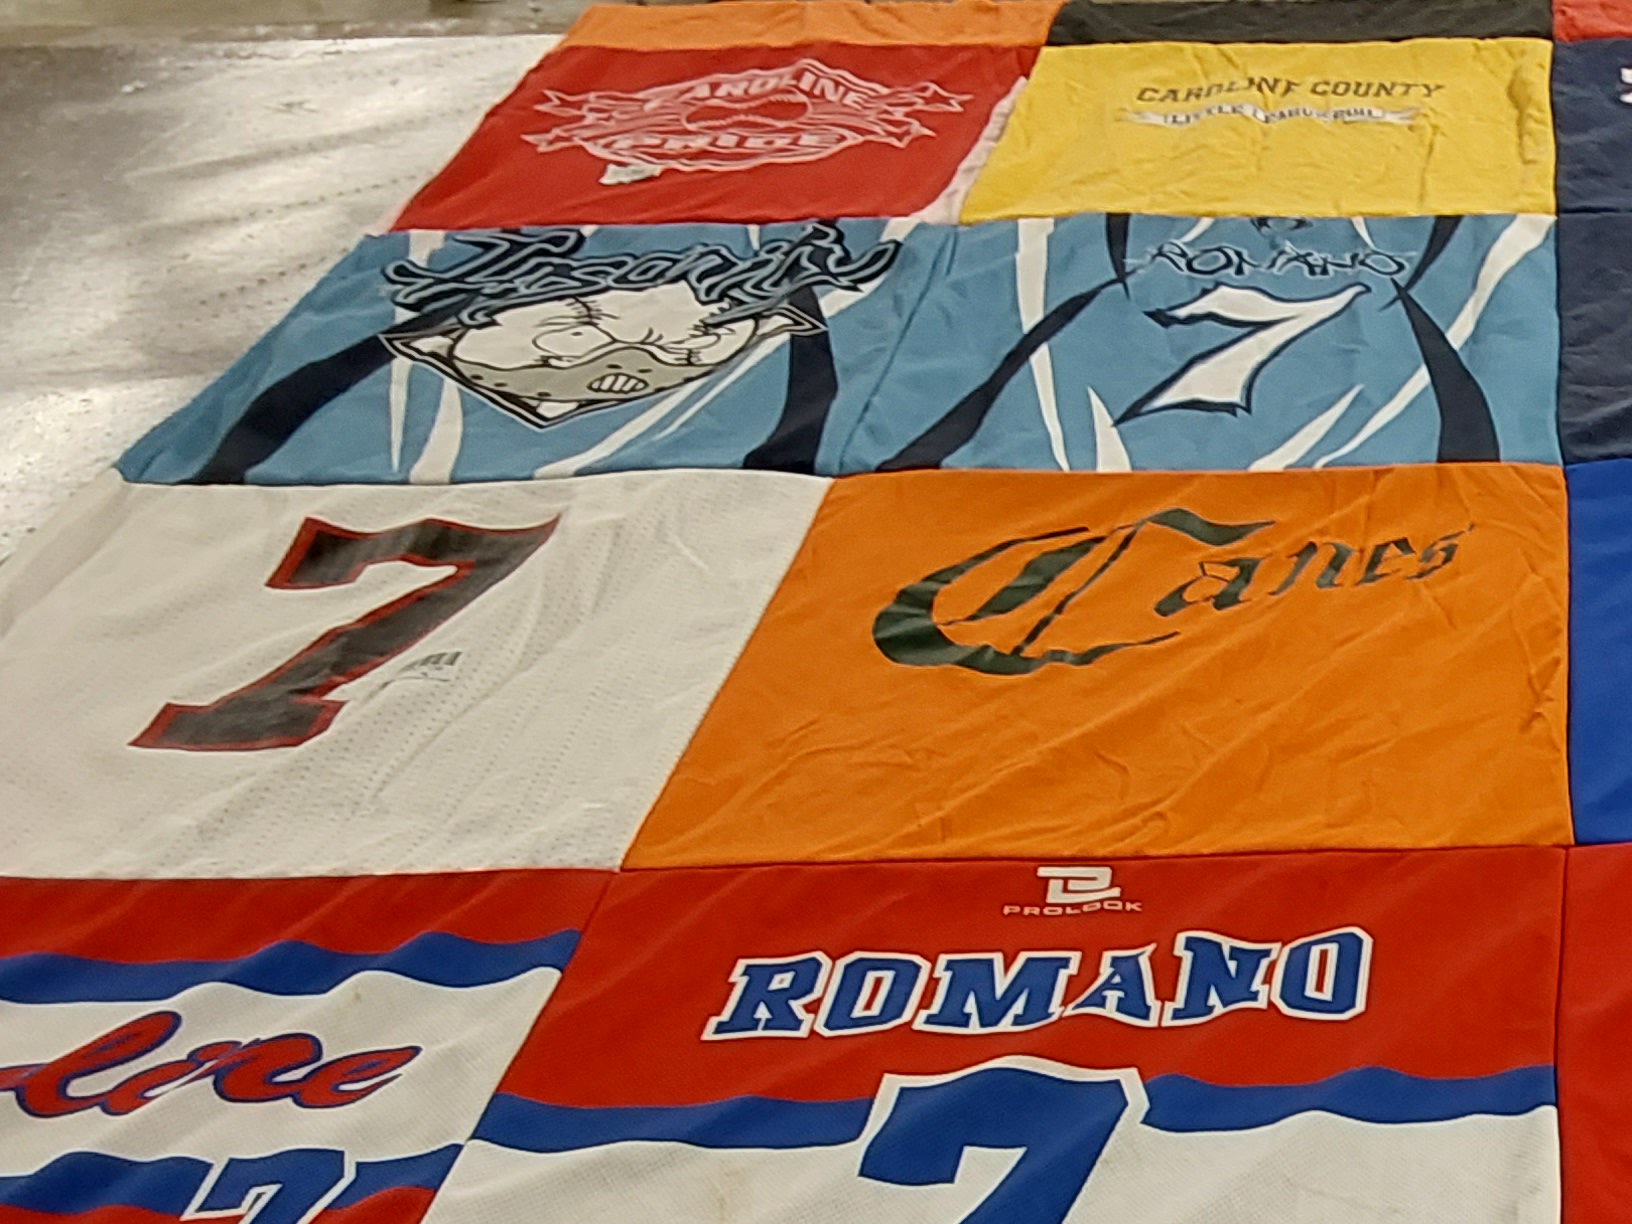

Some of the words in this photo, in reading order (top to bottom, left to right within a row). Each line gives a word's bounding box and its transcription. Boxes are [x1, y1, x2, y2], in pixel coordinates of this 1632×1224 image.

[1309, 80, 1444, 98] COUNTY
[1115, 280, 1372, 424] 7
[126, 514, 562, 752] 7
[871, 507, 1475, 676] Canes
[1002, 900, 1144, 917] PROLOOK
[700, 925, 1374, 1040] ROMANO
